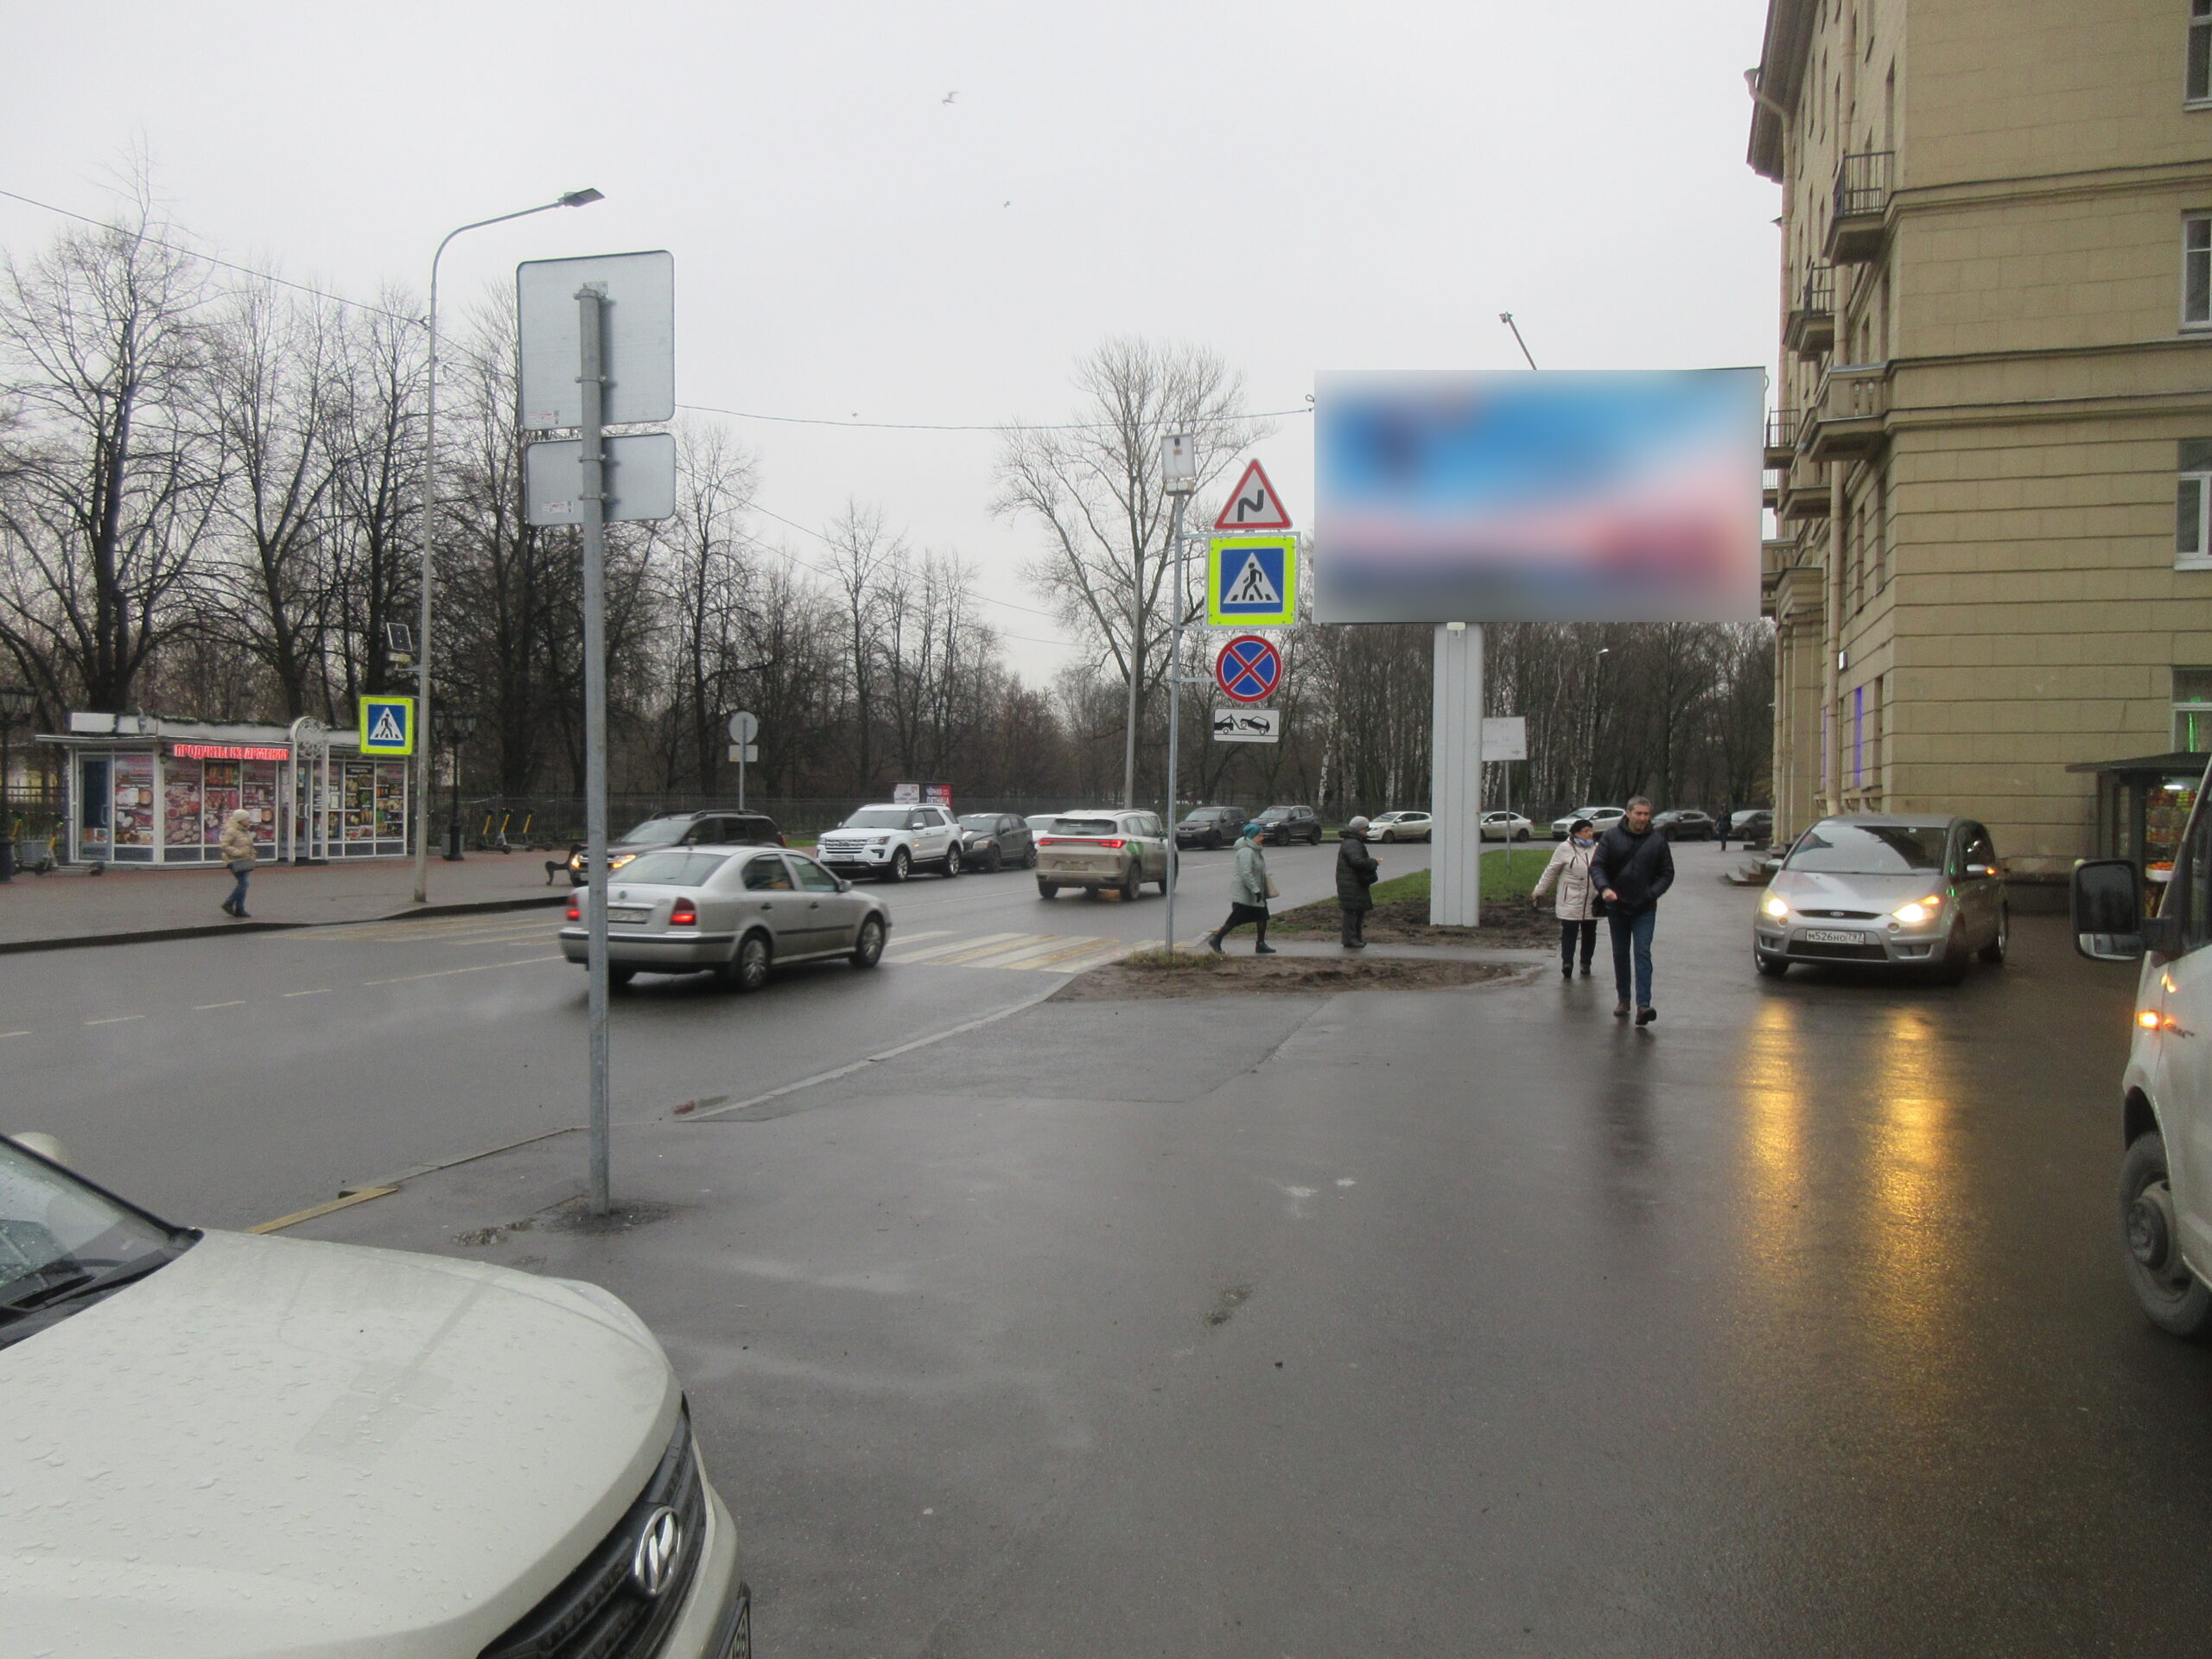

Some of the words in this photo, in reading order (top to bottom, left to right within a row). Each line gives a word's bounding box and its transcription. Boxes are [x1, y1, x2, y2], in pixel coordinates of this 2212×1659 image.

[175, 744, 228, 759] ПРОДУКТЫ
[230, 747, 243, 760] ИЗ
[244, 747, 290, 760] АРМЕНИИ
